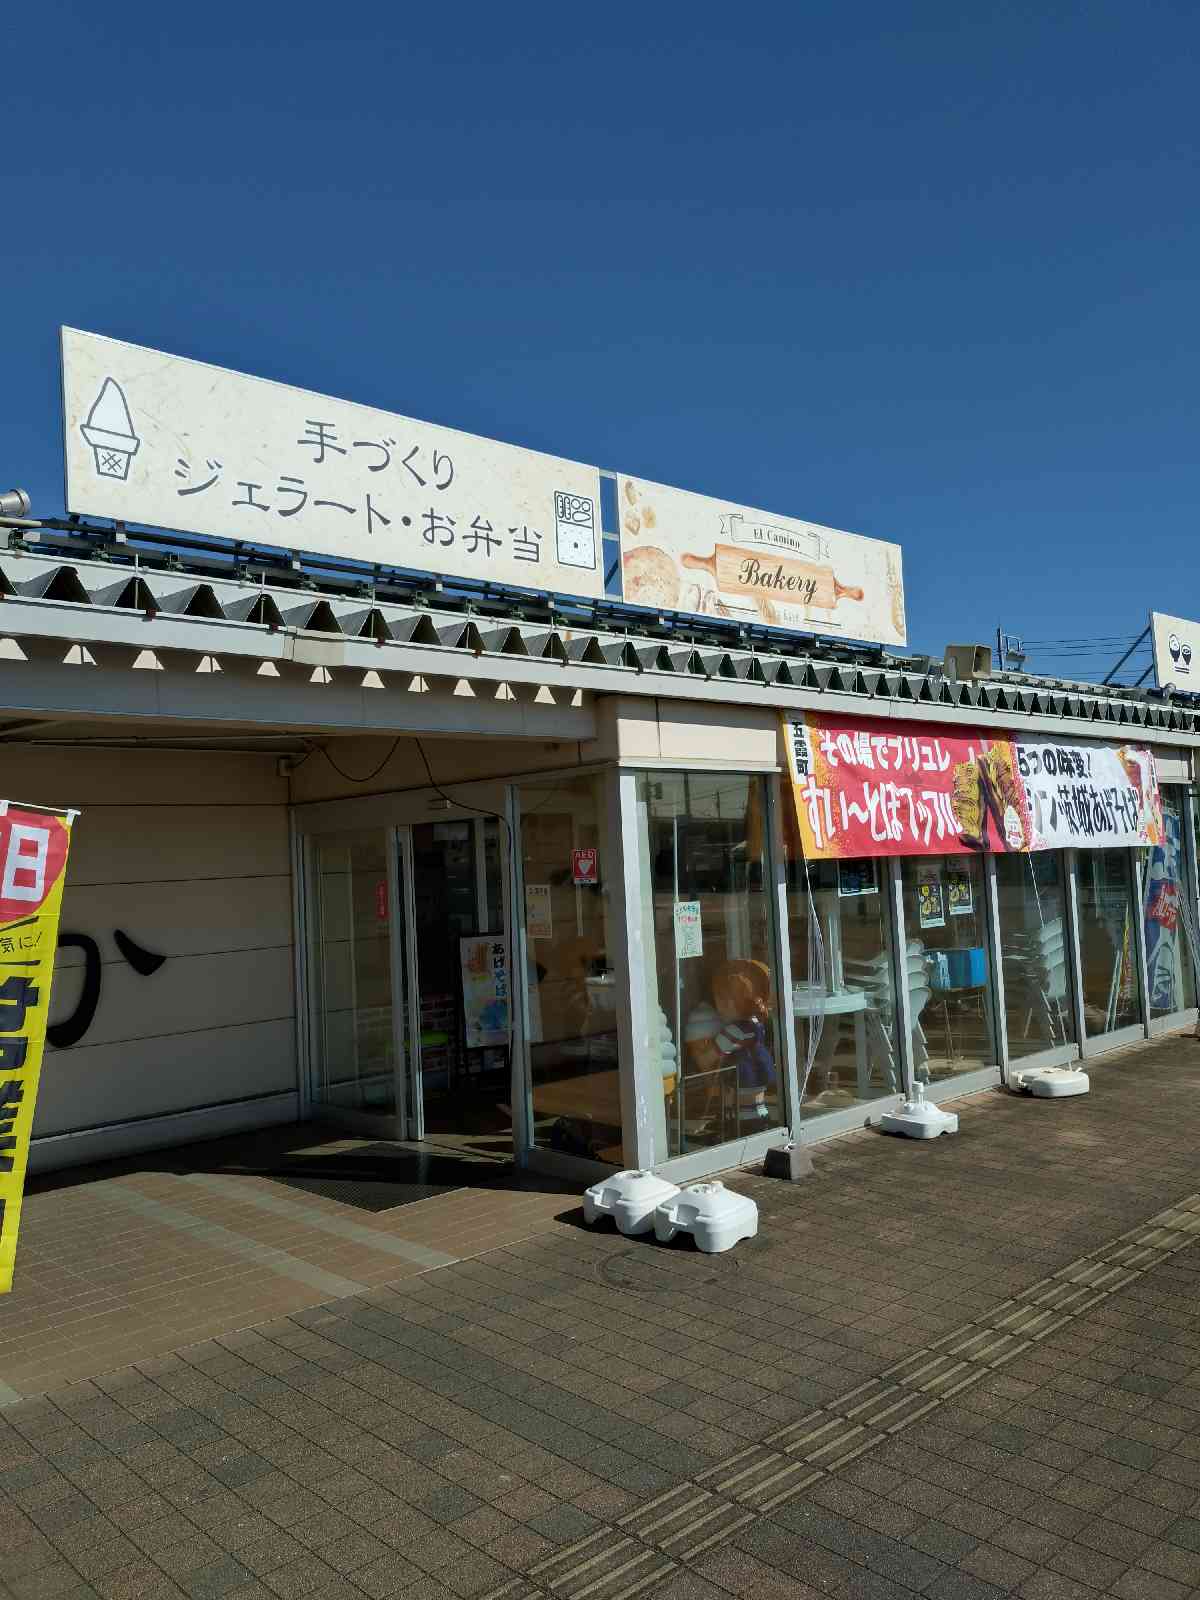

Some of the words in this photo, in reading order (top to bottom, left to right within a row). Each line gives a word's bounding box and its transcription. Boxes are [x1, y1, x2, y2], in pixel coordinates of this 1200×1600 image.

[296, 419, 456, 491] 手づくり
[173, 457, 542, 564] ジェラート・お弁当
[753, 527, 763, 541] El
[766, 530, 801, 551] Camino
[738, 557, 818, 605] Bakery
